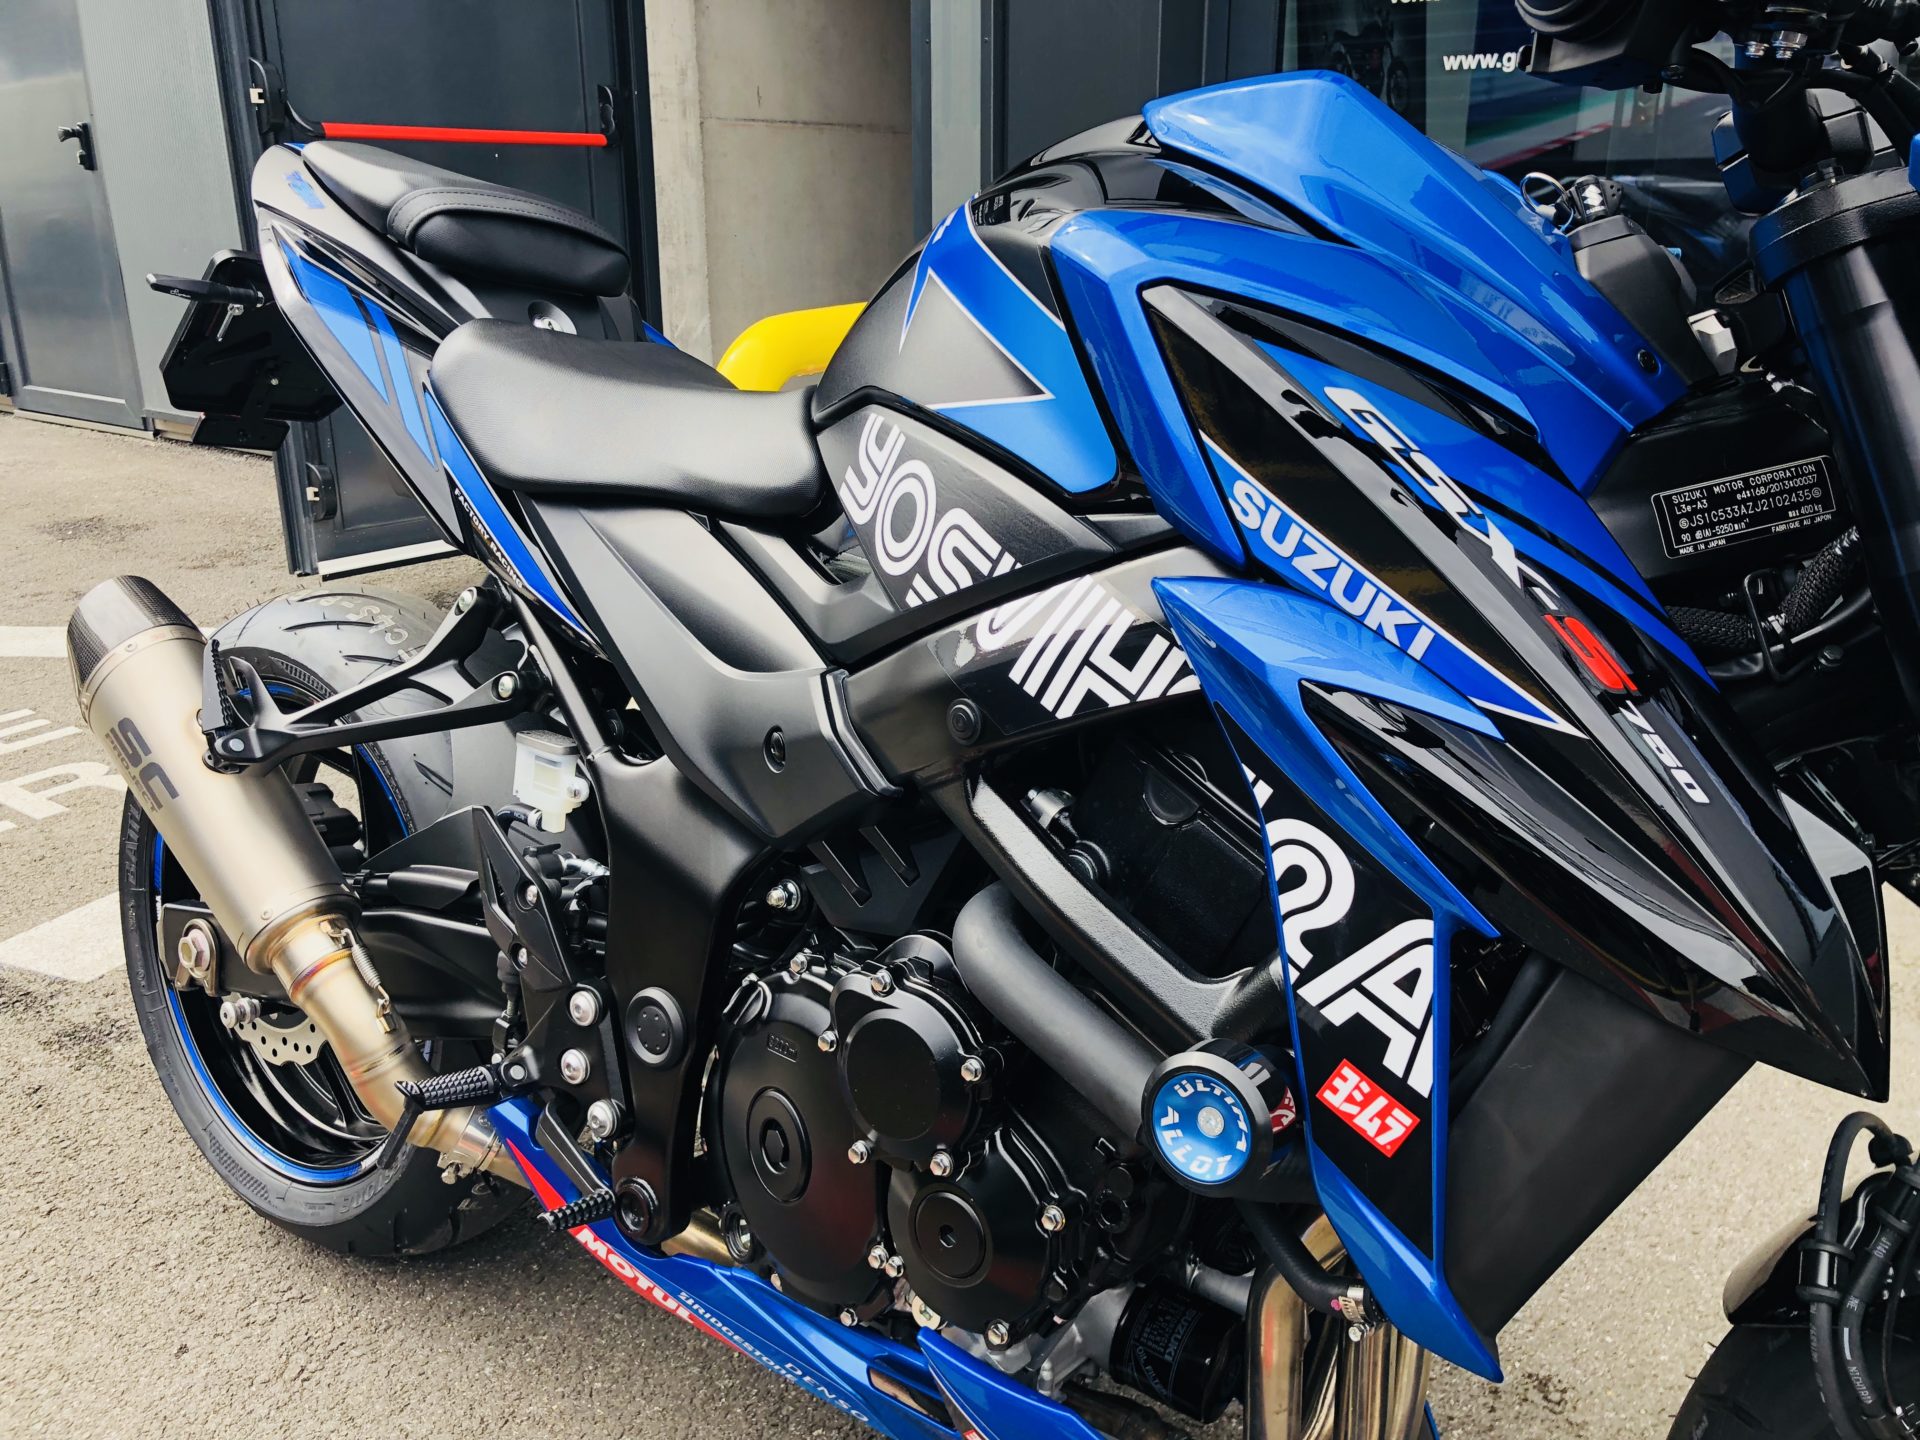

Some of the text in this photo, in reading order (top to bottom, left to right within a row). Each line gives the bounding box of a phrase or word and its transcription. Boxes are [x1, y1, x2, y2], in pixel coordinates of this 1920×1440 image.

[1442, 51, 1520, 73] www.g
[1671, 463, 1816, 504] SUZUKI MOTOR CORPORATION
[1674, 499, 1709, 515] L3e-A3
[1813, 513, 1832, 524] JAPON
[453, 487, 524, 589] FACTORY RACING
[1679, 538, 1727, 555] MADE IN JAPAN
[1681, 532, 1692, 543] 90
[1800, 504, 1814, 515] 400
[1228, 480, 1438, 662] SUZUKI
[109, 717, 180, 811] SC
[1616, 701, 1710, 804] 750
[1322, 1066, 1413, 1144] ヨシムラ
[575, 1227, 694, 1324] MOTUL
[676, 1290, 799, 1383] BRIDGESTONE
[784, 1361, 870, 1423] DENSO
